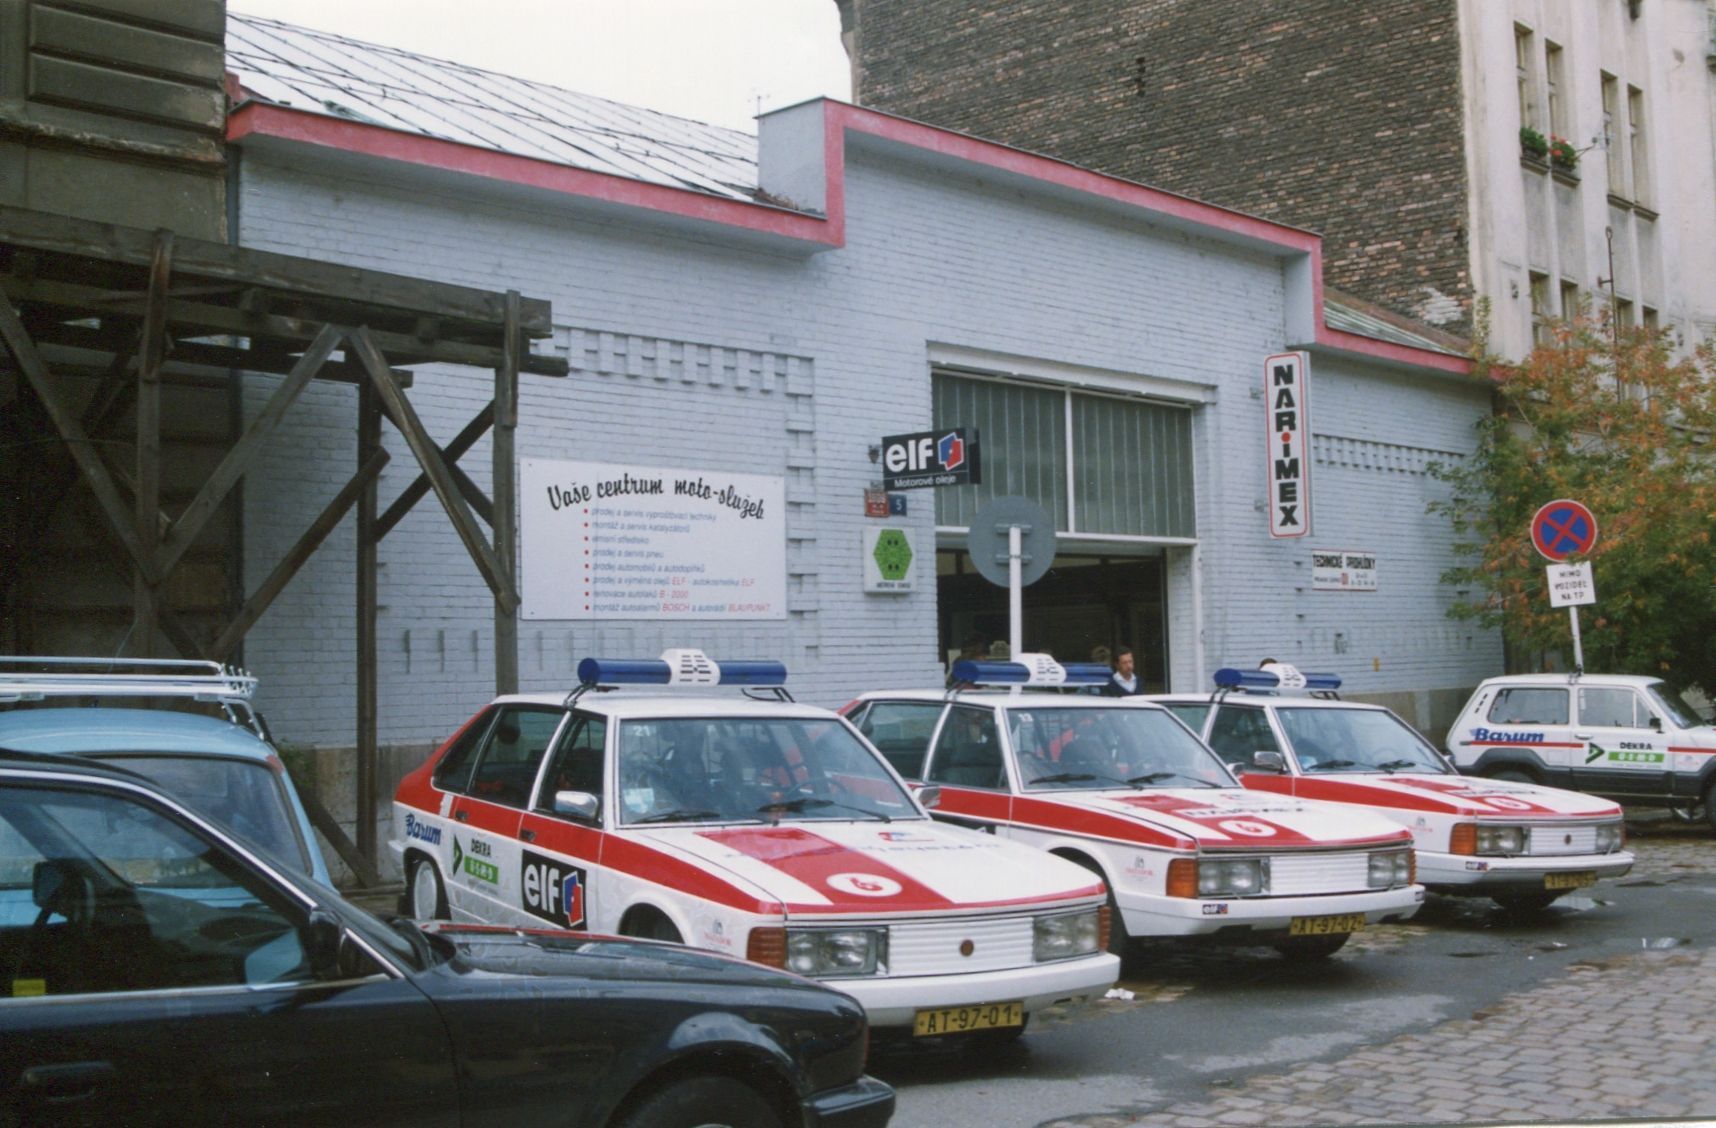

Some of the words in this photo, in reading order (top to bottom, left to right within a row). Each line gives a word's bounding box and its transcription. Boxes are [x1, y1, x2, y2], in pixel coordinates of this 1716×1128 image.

[886, 438, 933, 472] elf
[547, 482, 592, 511] Vaše
[597, 472, 664, 498] centrum
[895, 476, 933, 488] Motorové
[935, 475, 957, 486] oleje
[1471, 727, 1544, 744] Barum
[1620, 742, 1653, 751] DEKRA
[405, 812, 442, 846] Barum
[471, 838, 491, 858] DEKRA
[524, 864, 560, 914] elf
[926, 1004, 1014, 1034] AT-97-01
